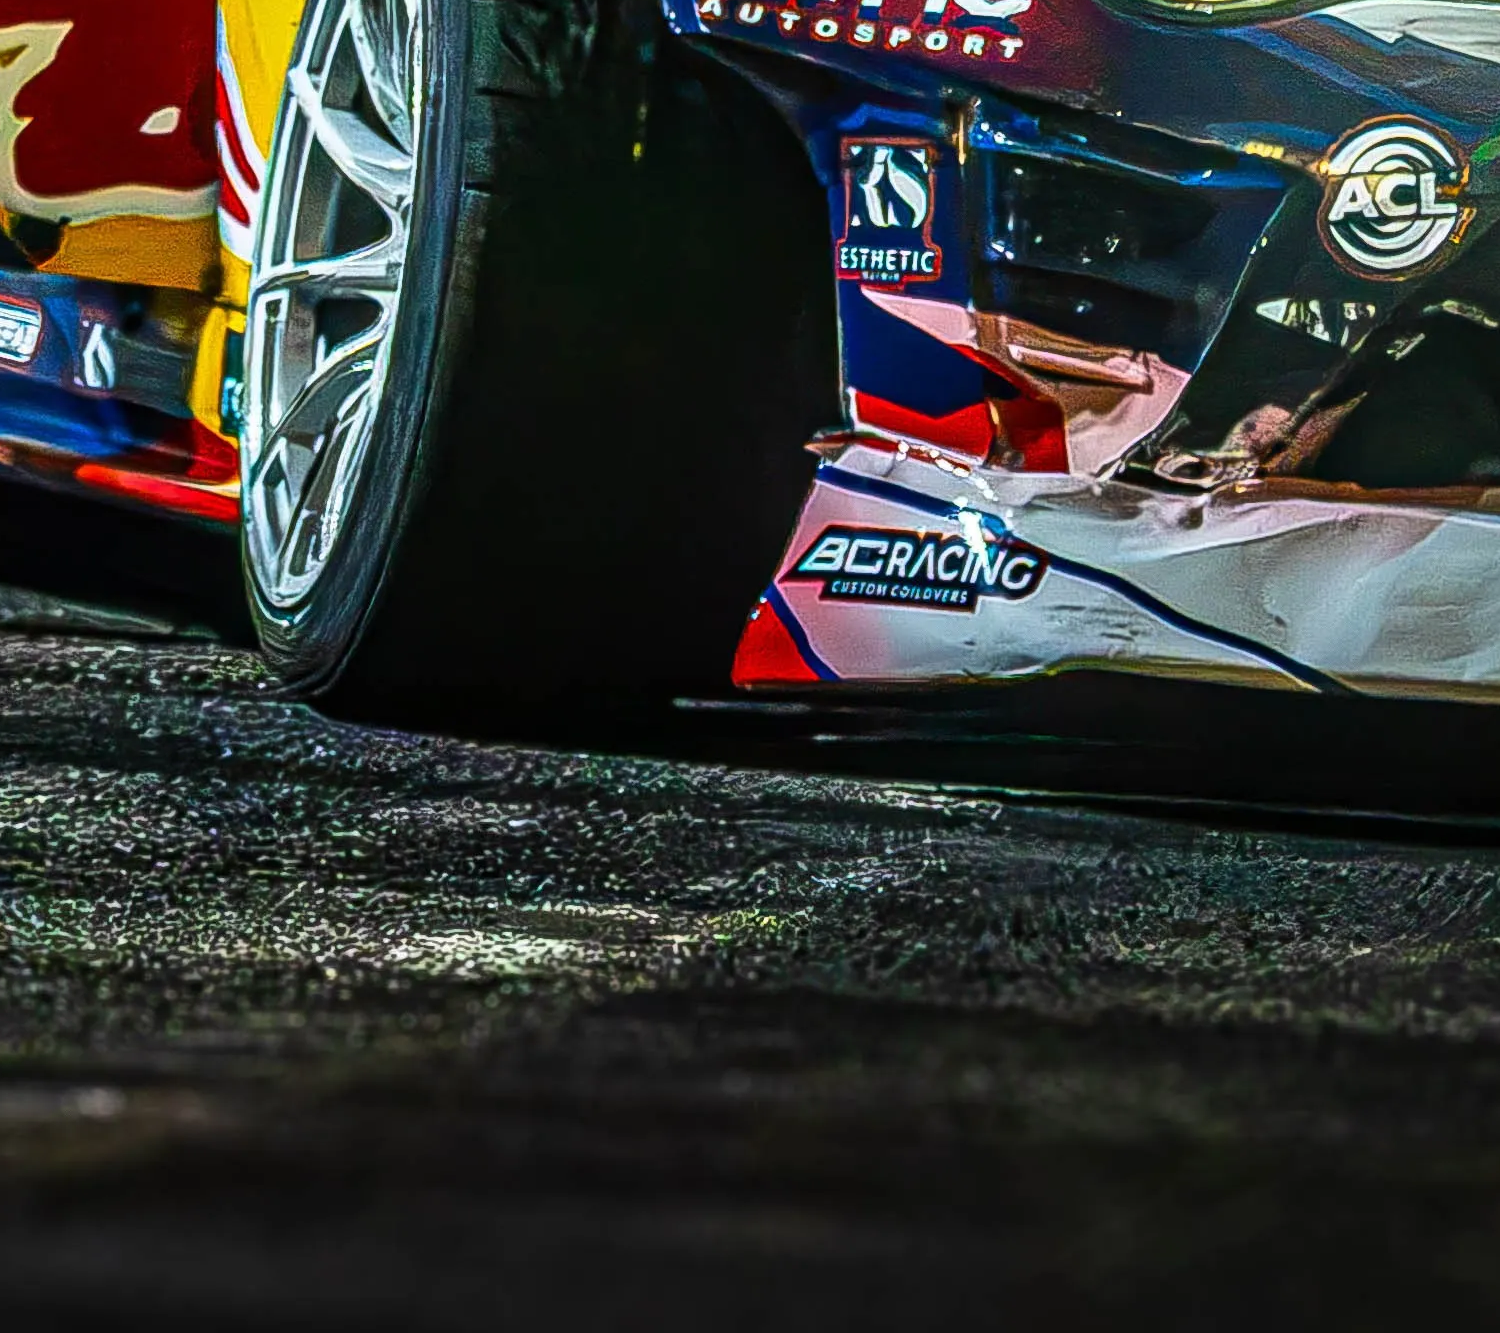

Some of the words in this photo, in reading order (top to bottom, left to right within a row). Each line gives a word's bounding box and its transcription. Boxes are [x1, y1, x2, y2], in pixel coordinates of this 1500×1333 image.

[1327, 172, 1458, 222] ACL
[840, 247, 936, 273] ESTHETIC
[830, 580, 888, 598] CUSTOM
[890, 586, 968, 604] COILOVERS
